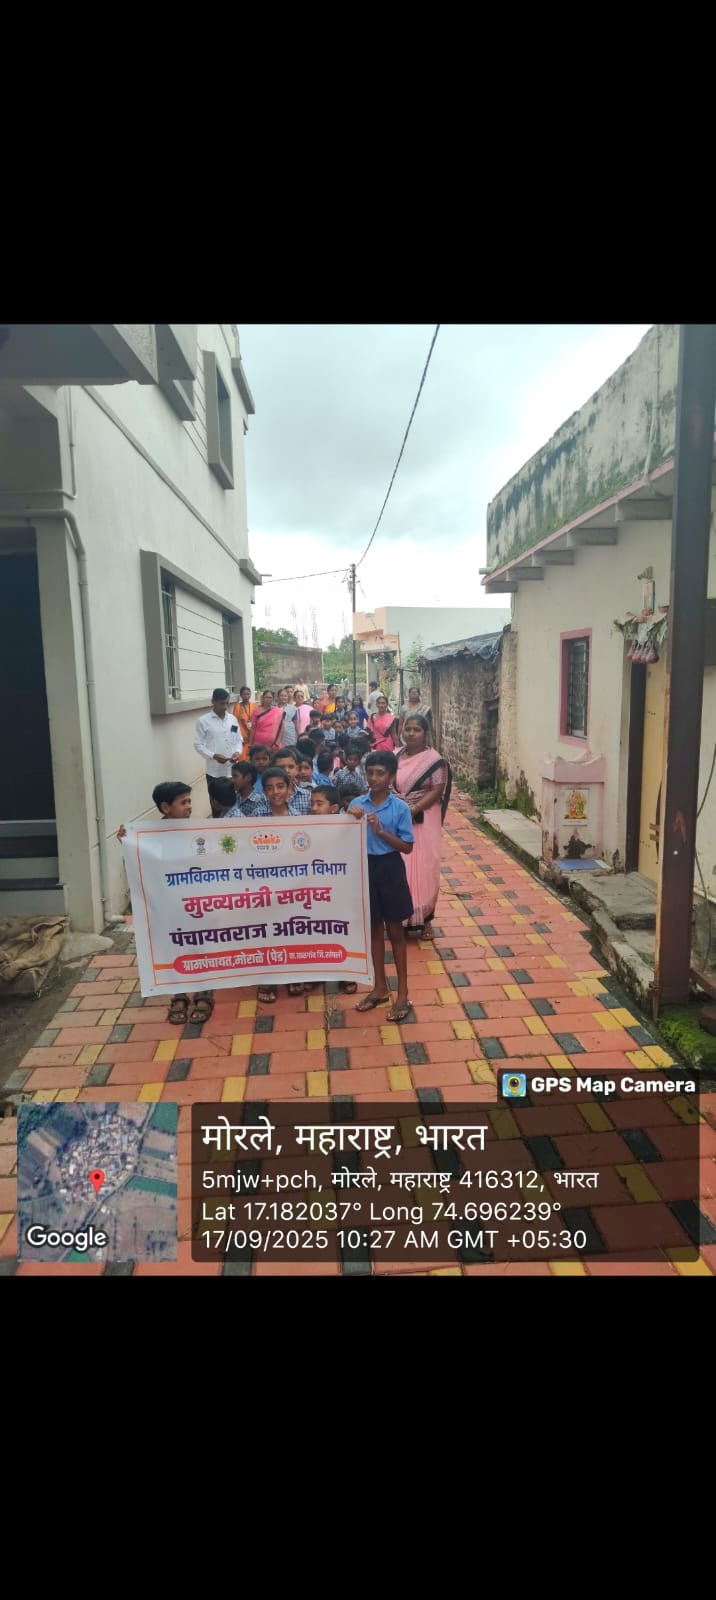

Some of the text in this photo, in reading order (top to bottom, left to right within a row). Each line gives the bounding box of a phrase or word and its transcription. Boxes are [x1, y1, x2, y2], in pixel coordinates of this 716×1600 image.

[165, 859, 347, 887] ग्रामविकास व पंचायतराज विभाग
[182, 885, 272, 918] मुख्यमंत्री
[169, 916, 350, 947] पंचायतराज अभियान
[266, 948, 288, 964] (पेड)
